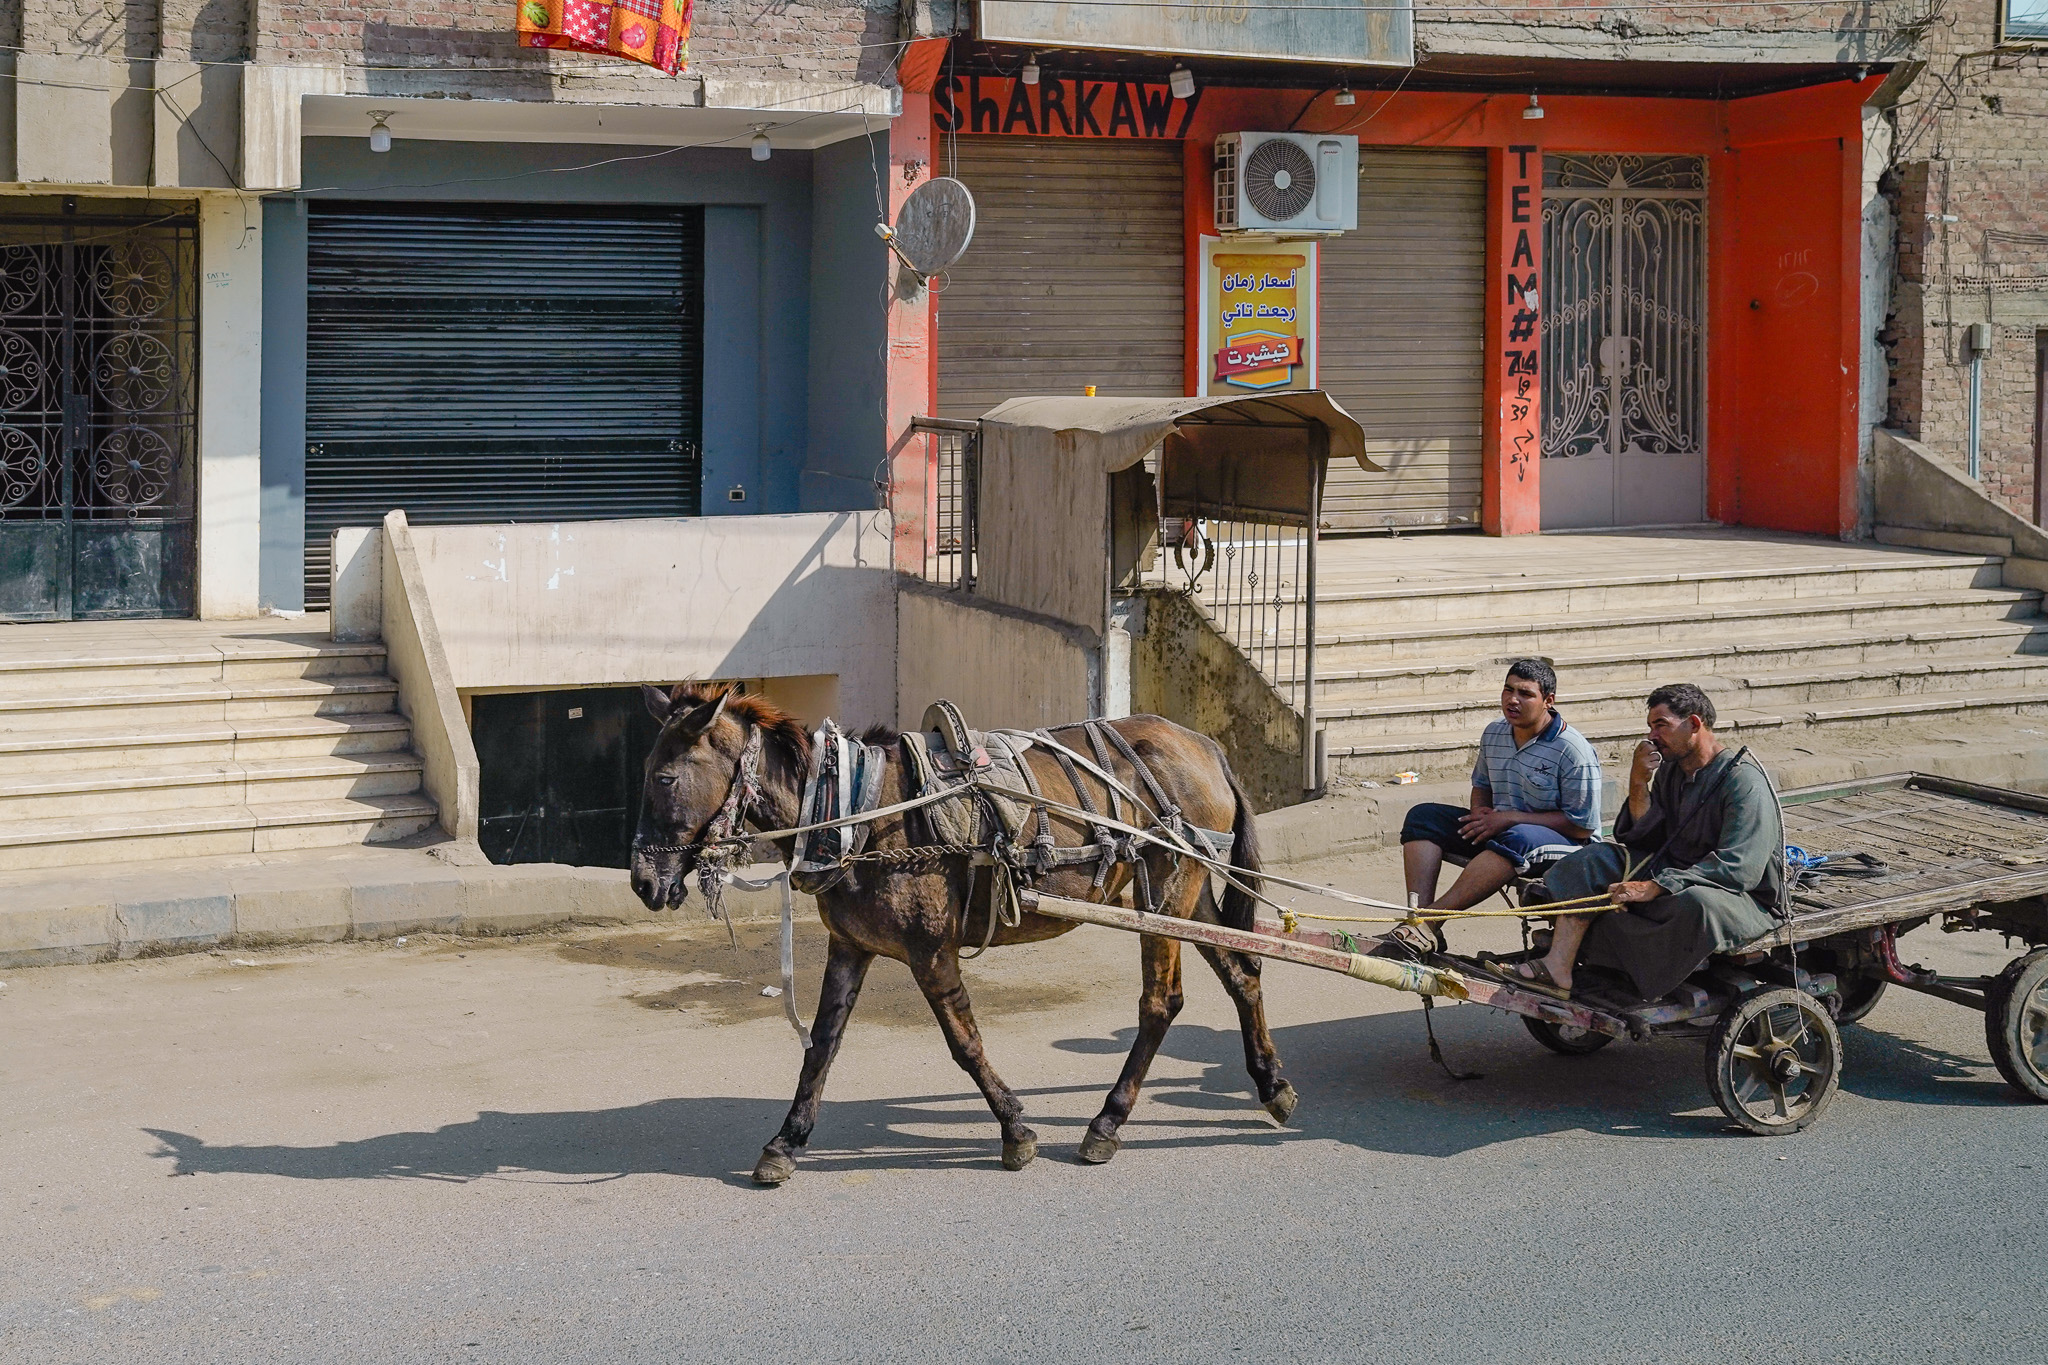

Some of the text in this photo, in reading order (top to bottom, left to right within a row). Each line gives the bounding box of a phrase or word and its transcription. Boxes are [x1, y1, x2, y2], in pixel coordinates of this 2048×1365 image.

[1222, 269, 1296, 292] أسعار زمان
[1222, 302, 1296, 328] رجعت تاني
[1226, 343, 1291, 368] تيشيرت
